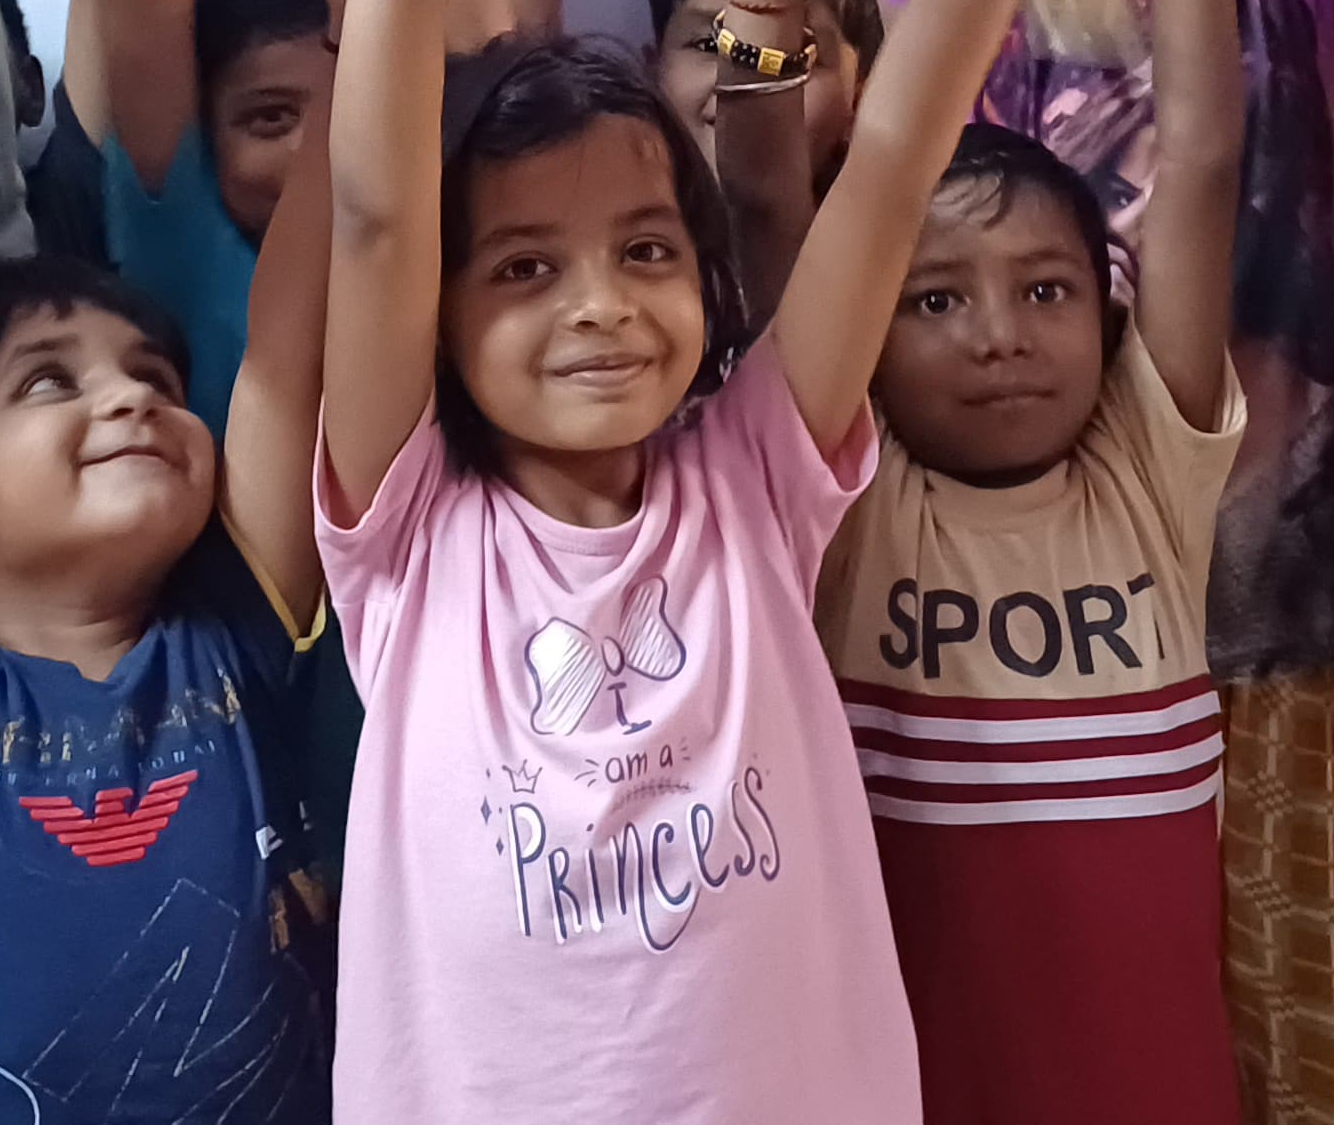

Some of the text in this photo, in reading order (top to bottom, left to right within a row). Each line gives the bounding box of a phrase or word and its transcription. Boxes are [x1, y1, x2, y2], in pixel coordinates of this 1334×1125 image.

[607, 682, 653, 735] I
[604, 744, 674, 784] am a
